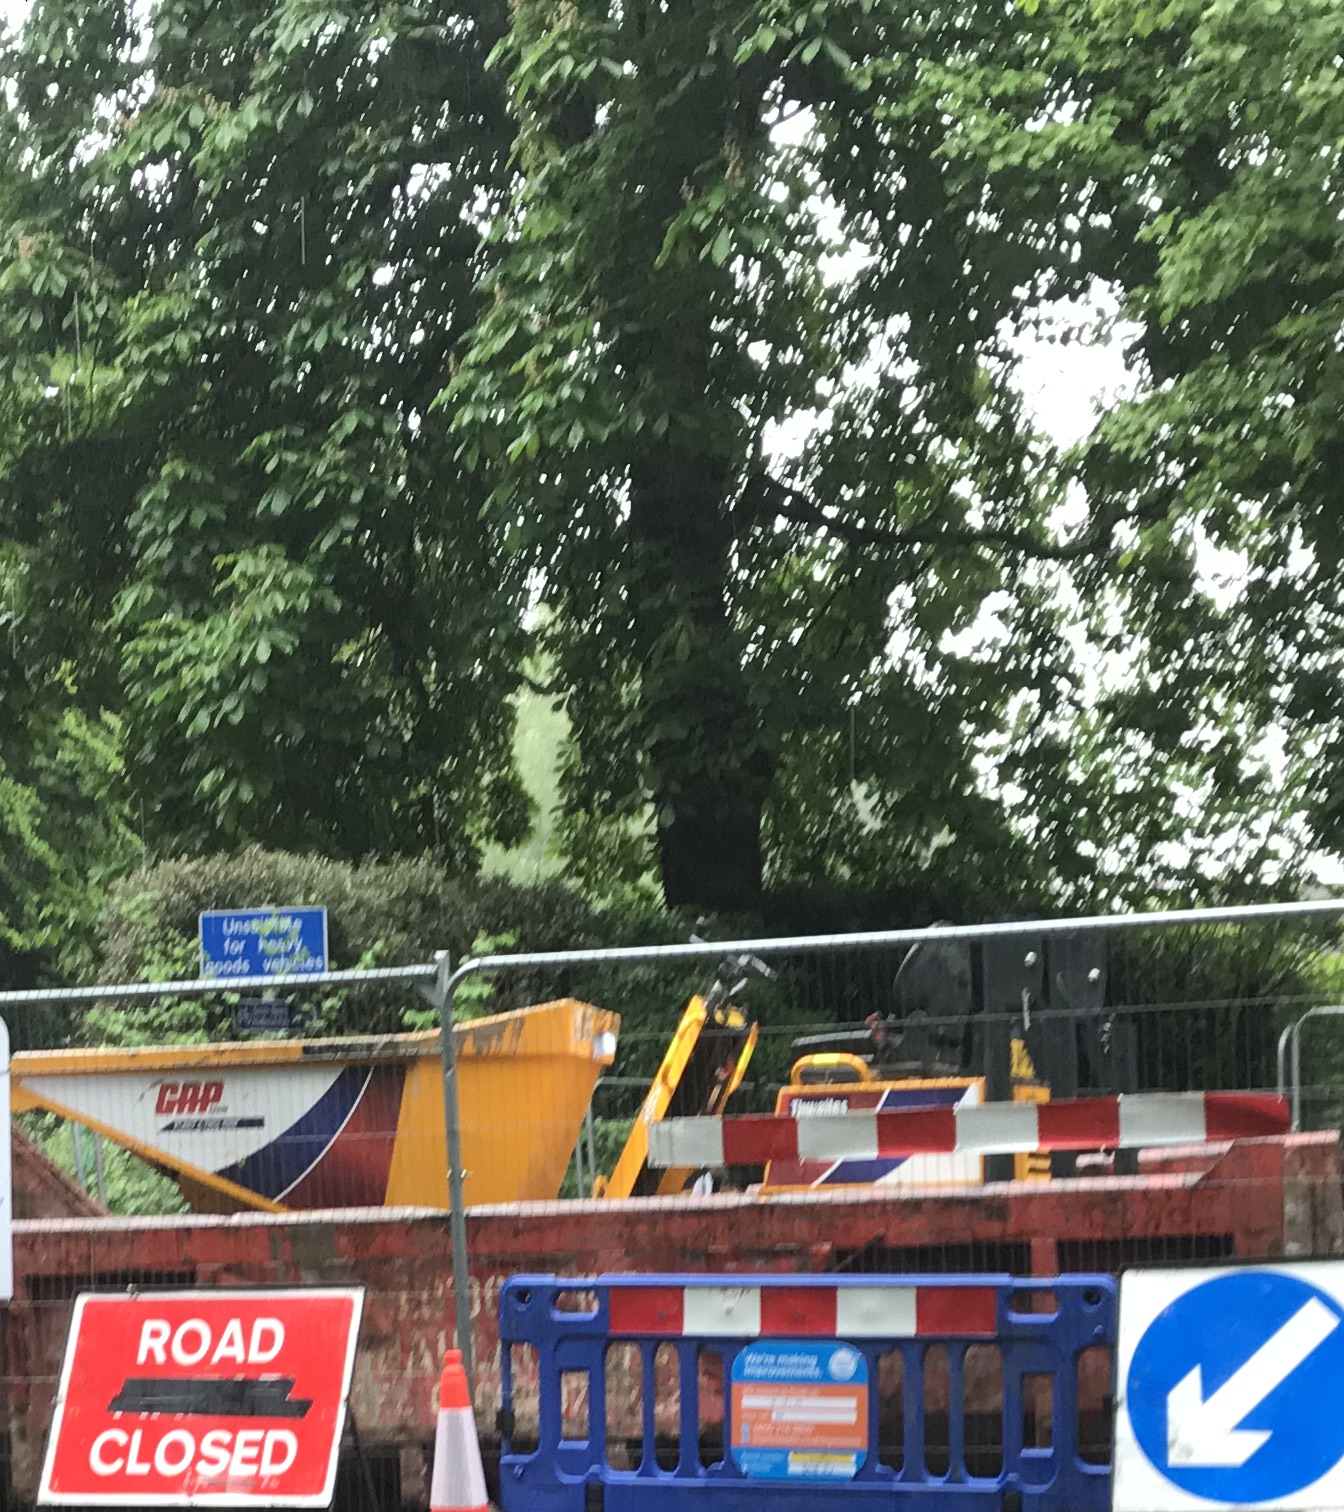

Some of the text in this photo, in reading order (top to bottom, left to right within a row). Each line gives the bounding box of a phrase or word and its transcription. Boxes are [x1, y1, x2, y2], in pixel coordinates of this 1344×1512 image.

[223, 937, 246, 956] for
[136, 1317, 285, 1366] ROAD
[89, 1428, 298, 1476] CLOSED
